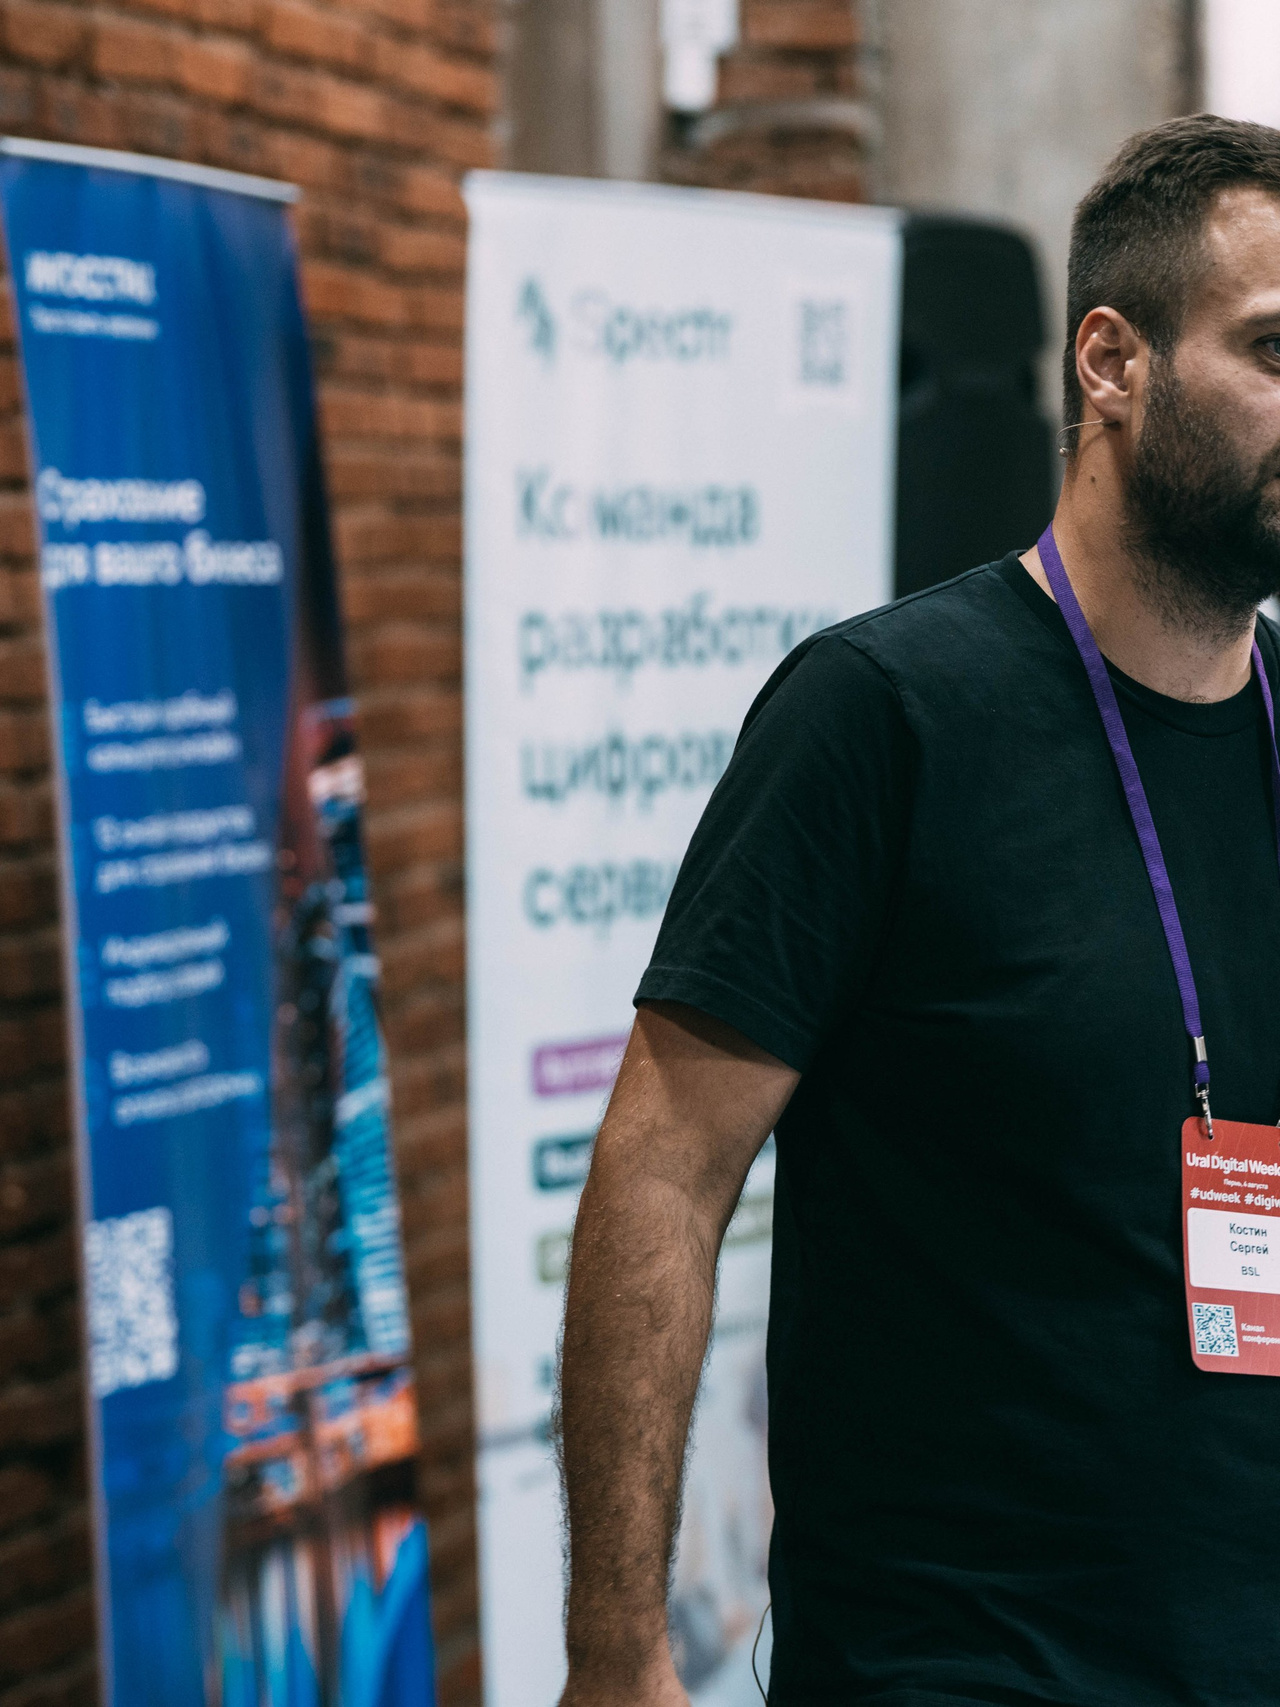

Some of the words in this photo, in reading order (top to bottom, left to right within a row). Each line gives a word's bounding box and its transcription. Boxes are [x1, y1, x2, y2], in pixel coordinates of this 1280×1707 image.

[521, 724, 734, 811] цифров
[1186, 1152, 1210, 1168] Ural
[1211, 1155, 1248, 1174] Digital
[1190, 1187, 1241, 1203] #udweek
[1229, 1222, 1267, 1237] Костин
[1230, 1240, 1269, 1256] Сергей
[1241, 1265, 1260, 1277] BSL
